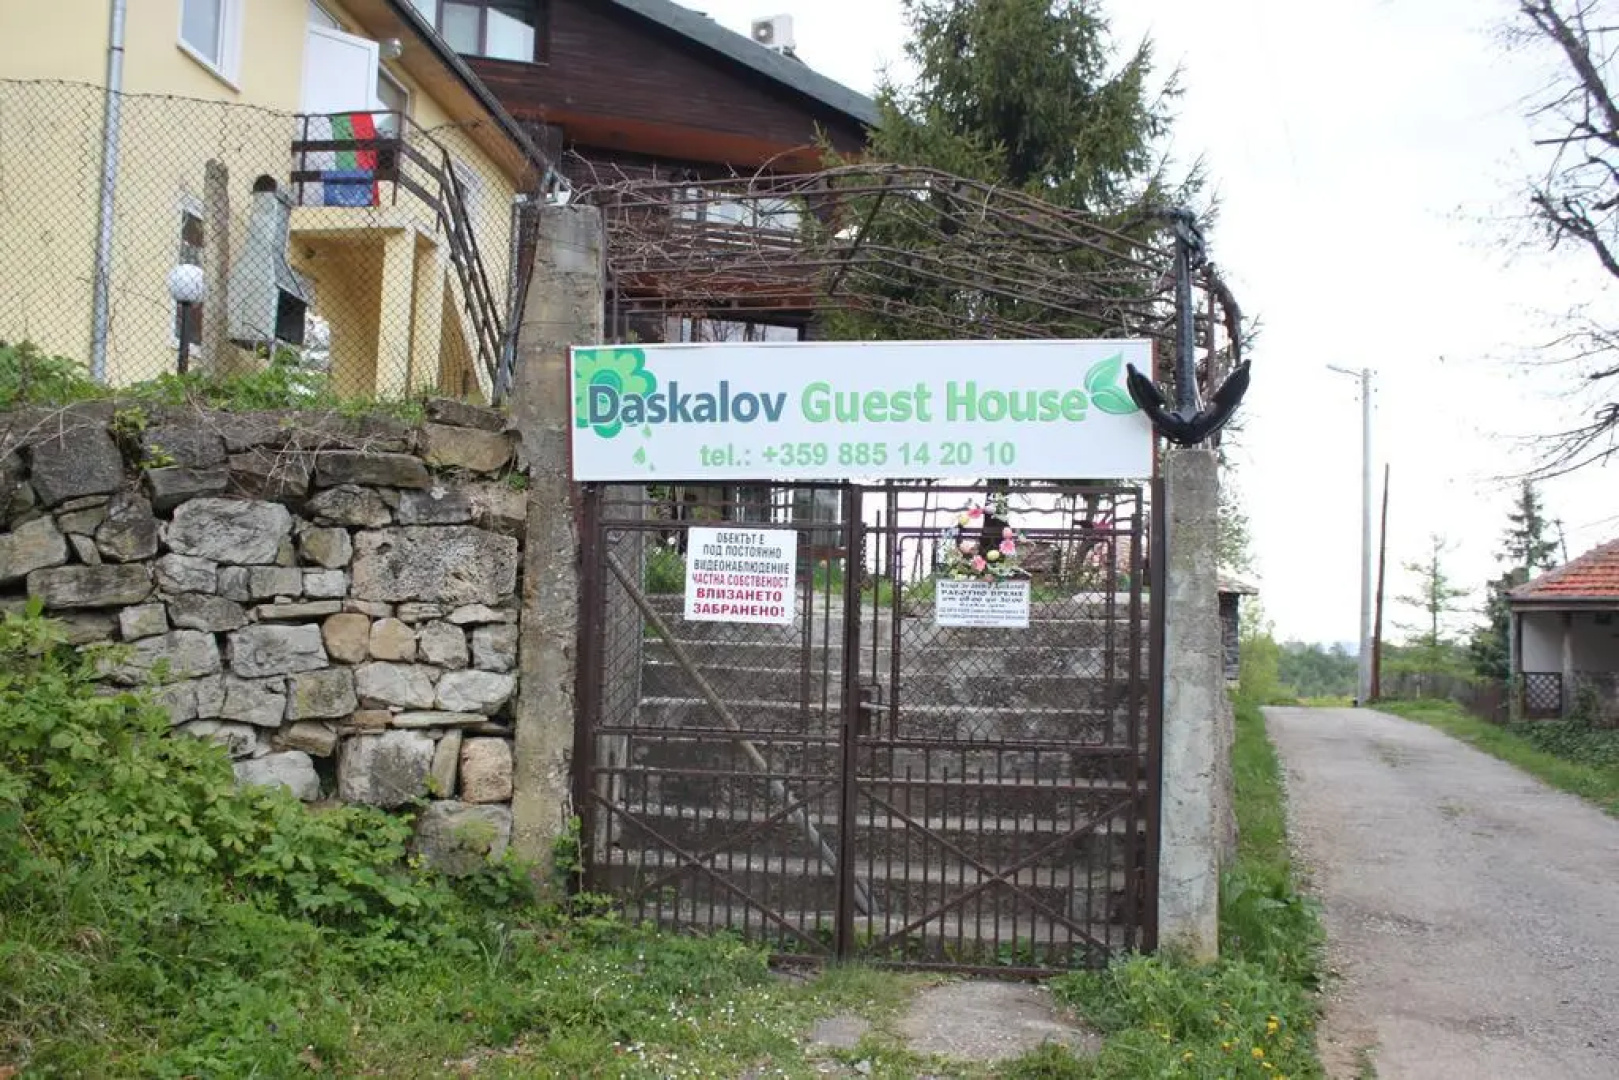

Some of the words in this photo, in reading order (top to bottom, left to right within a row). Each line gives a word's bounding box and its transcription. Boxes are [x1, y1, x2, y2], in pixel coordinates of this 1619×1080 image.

[589, 380, 786, 425] Daskalov
[801, 381, 932, 422] Guest
[946, 381, 1088, 422] House
[699, 443, 752, 468] tel.:
[761, 442, 828, 467] +359
[838, 442, 887, 467] 885
[898, 442, 930, 466] 14
[939, 442, 973, 466] 20
[983, 442, 1015, 466] 10
[716, 533, 756, 544] ОБЕКТЪТ
[759, 534, 764, 544] Е
[703, 544, 722, 556] ПОД
[726, 545, 781, 559] ПОСТОЯННО
[694, 560, 789, 574] ВИДЕОНАБЛЮДЕНИЕ
[692, 574, 725, 585] ЧАСТНА
[727, 575, 789, 588] СОБСТВЕНОСТ
[696, 588, 782, 602] ВЛИЗАНЕТО
[693, 603, 785, 617] ЗАБРАНЕНО!
